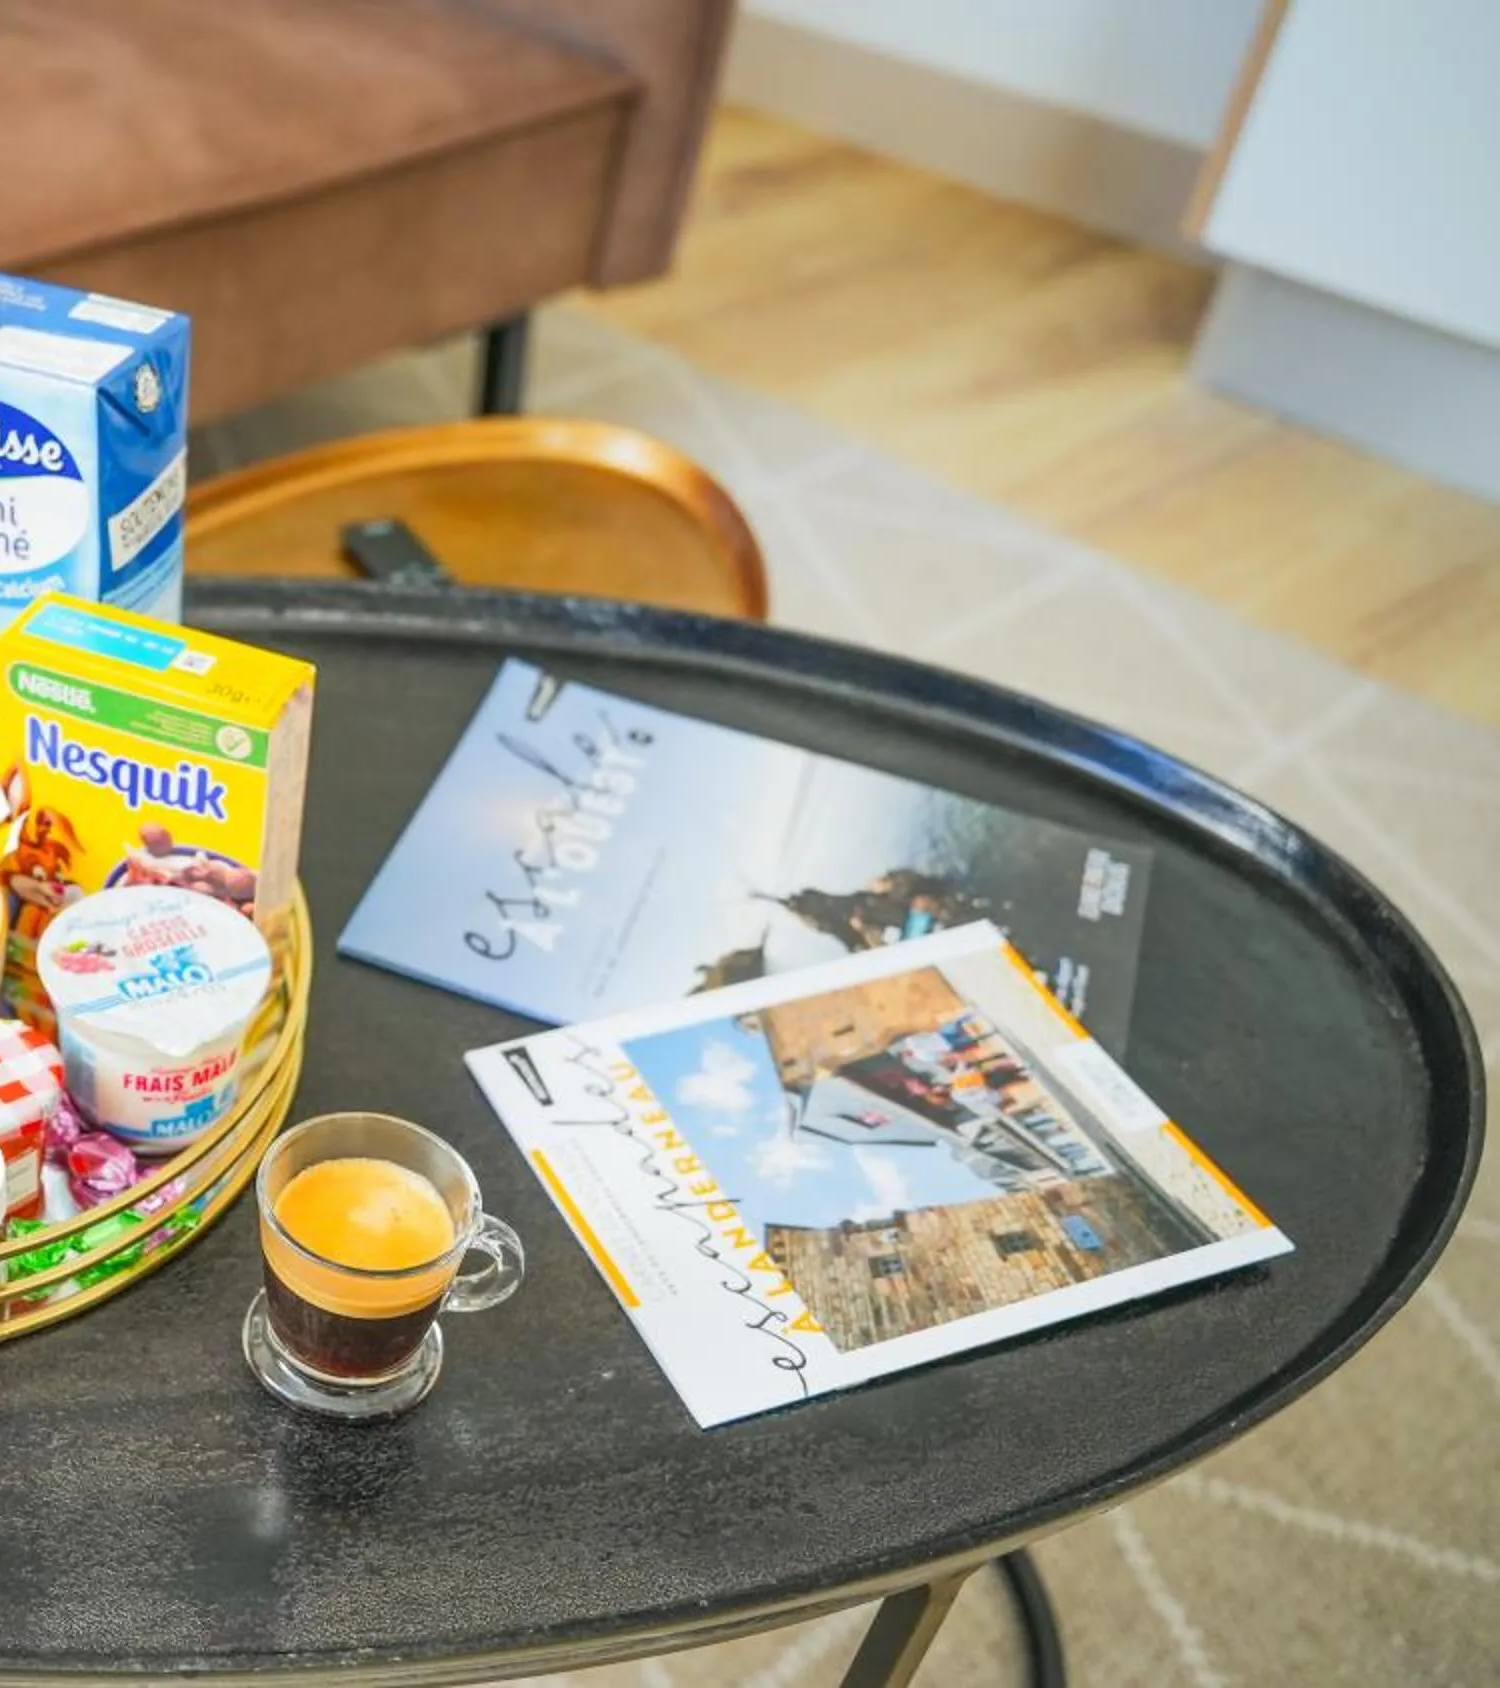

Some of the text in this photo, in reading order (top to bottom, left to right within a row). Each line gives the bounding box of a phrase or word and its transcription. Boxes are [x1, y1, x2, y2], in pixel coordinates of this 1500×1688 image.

[28, 717, 225, 820] Nesquik
[122, 1072, 186, 1093] FRAIS
[608, 1058, 798, 1298] LANDERNEAU
